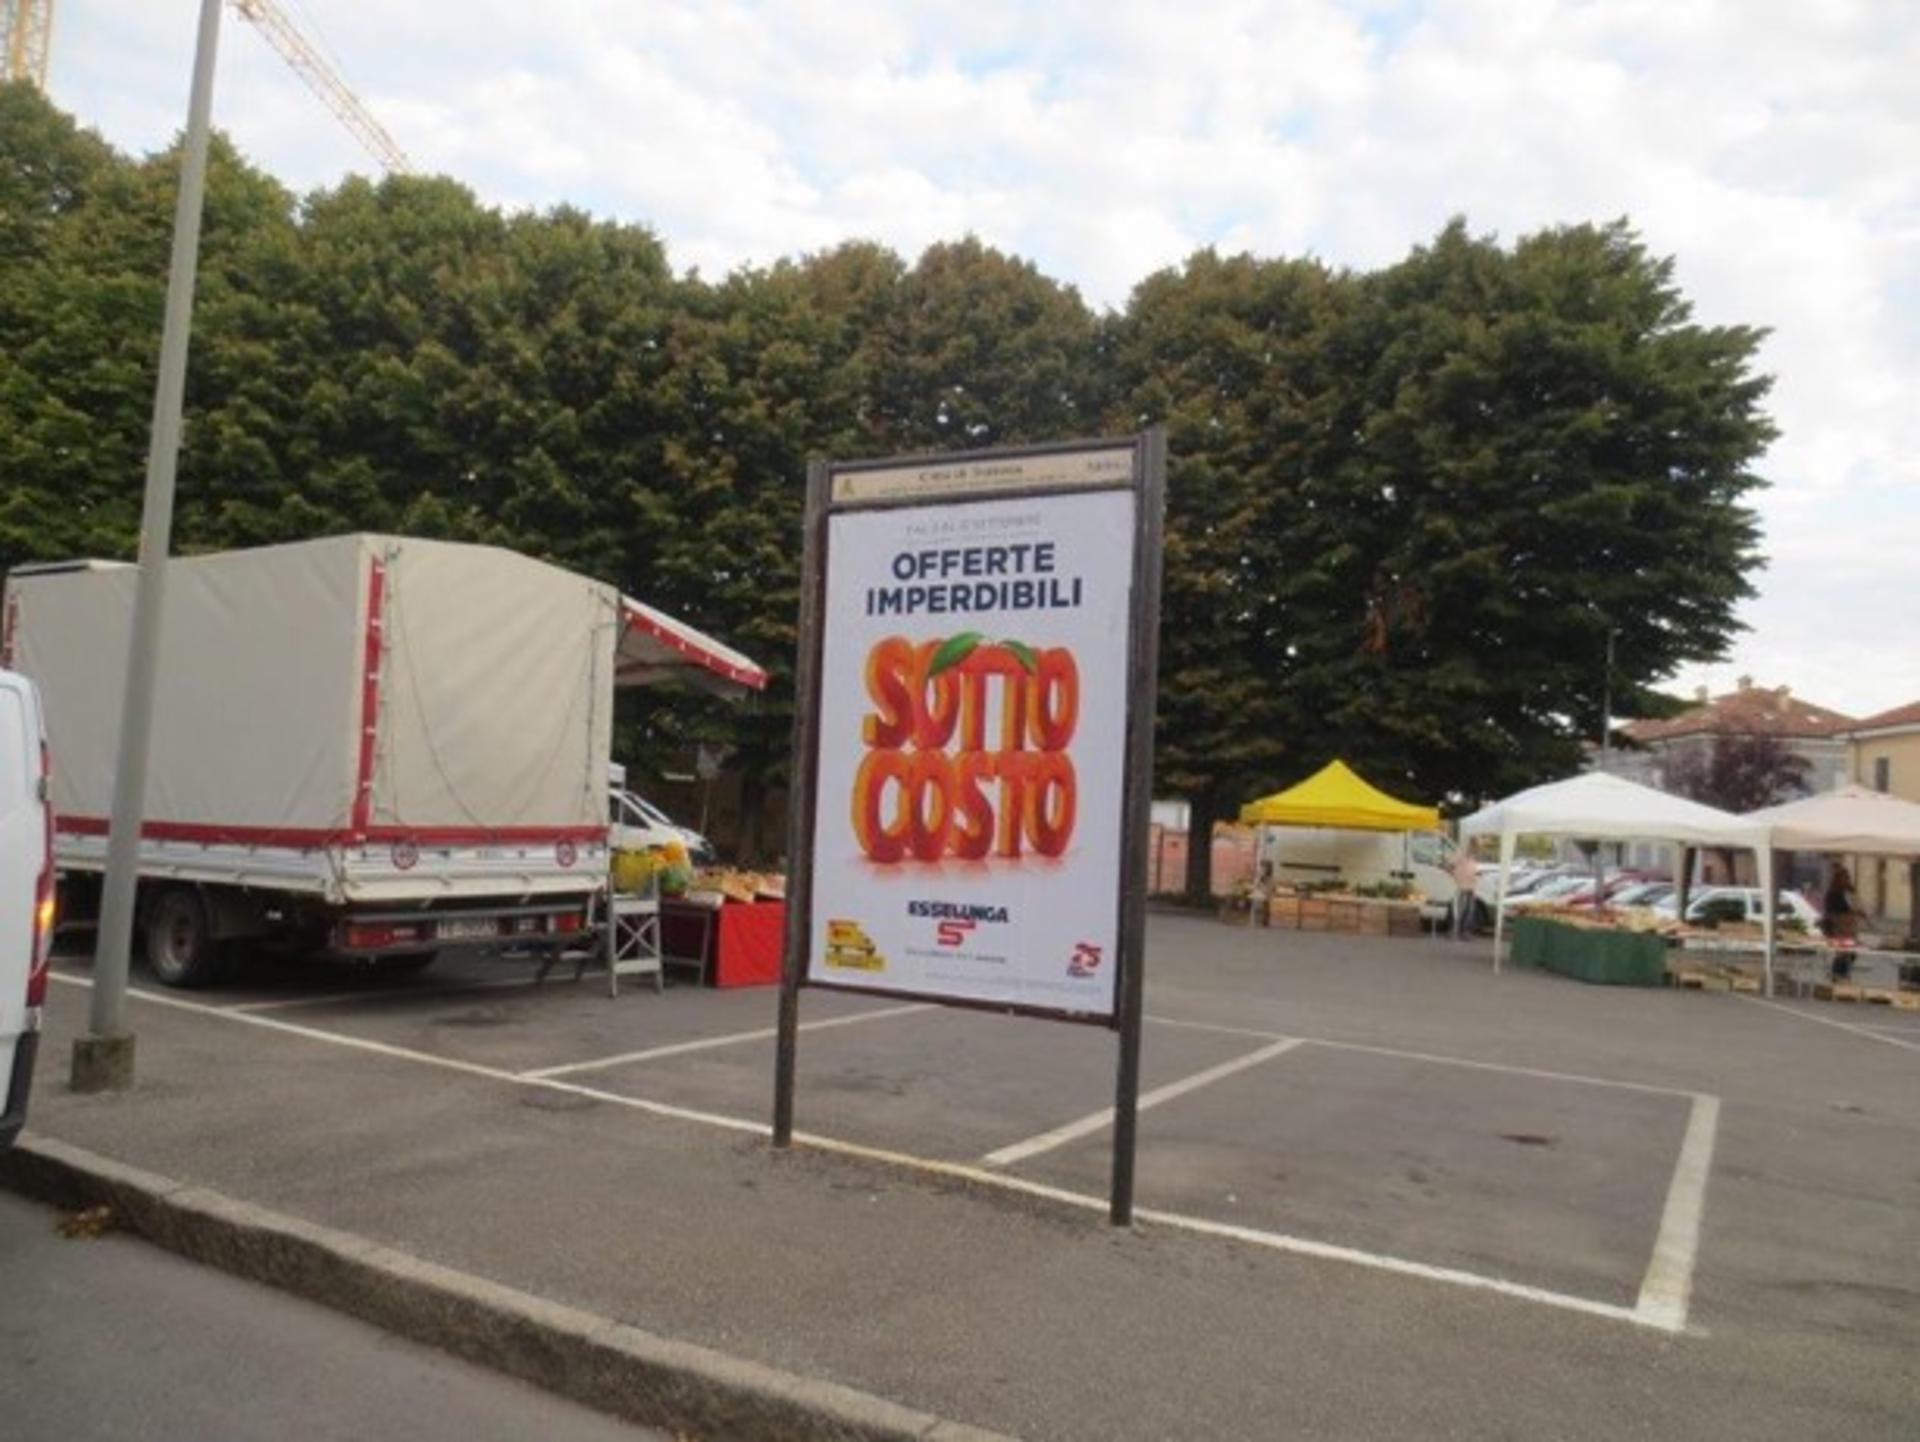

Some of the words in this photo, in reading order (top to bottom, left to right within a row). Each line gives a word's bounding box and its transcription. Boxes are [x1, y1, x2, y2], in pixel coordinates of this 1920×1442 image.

[891, 542, 1056, 581] OFFERTE
[866, 577, 1083, 616] IMPERDIBILI
[862, 635, 1079, 751] SOTTO
[851, 748, 1078, 864] COSTO
[907, 900, 1010, 923] ESSELUNGA
